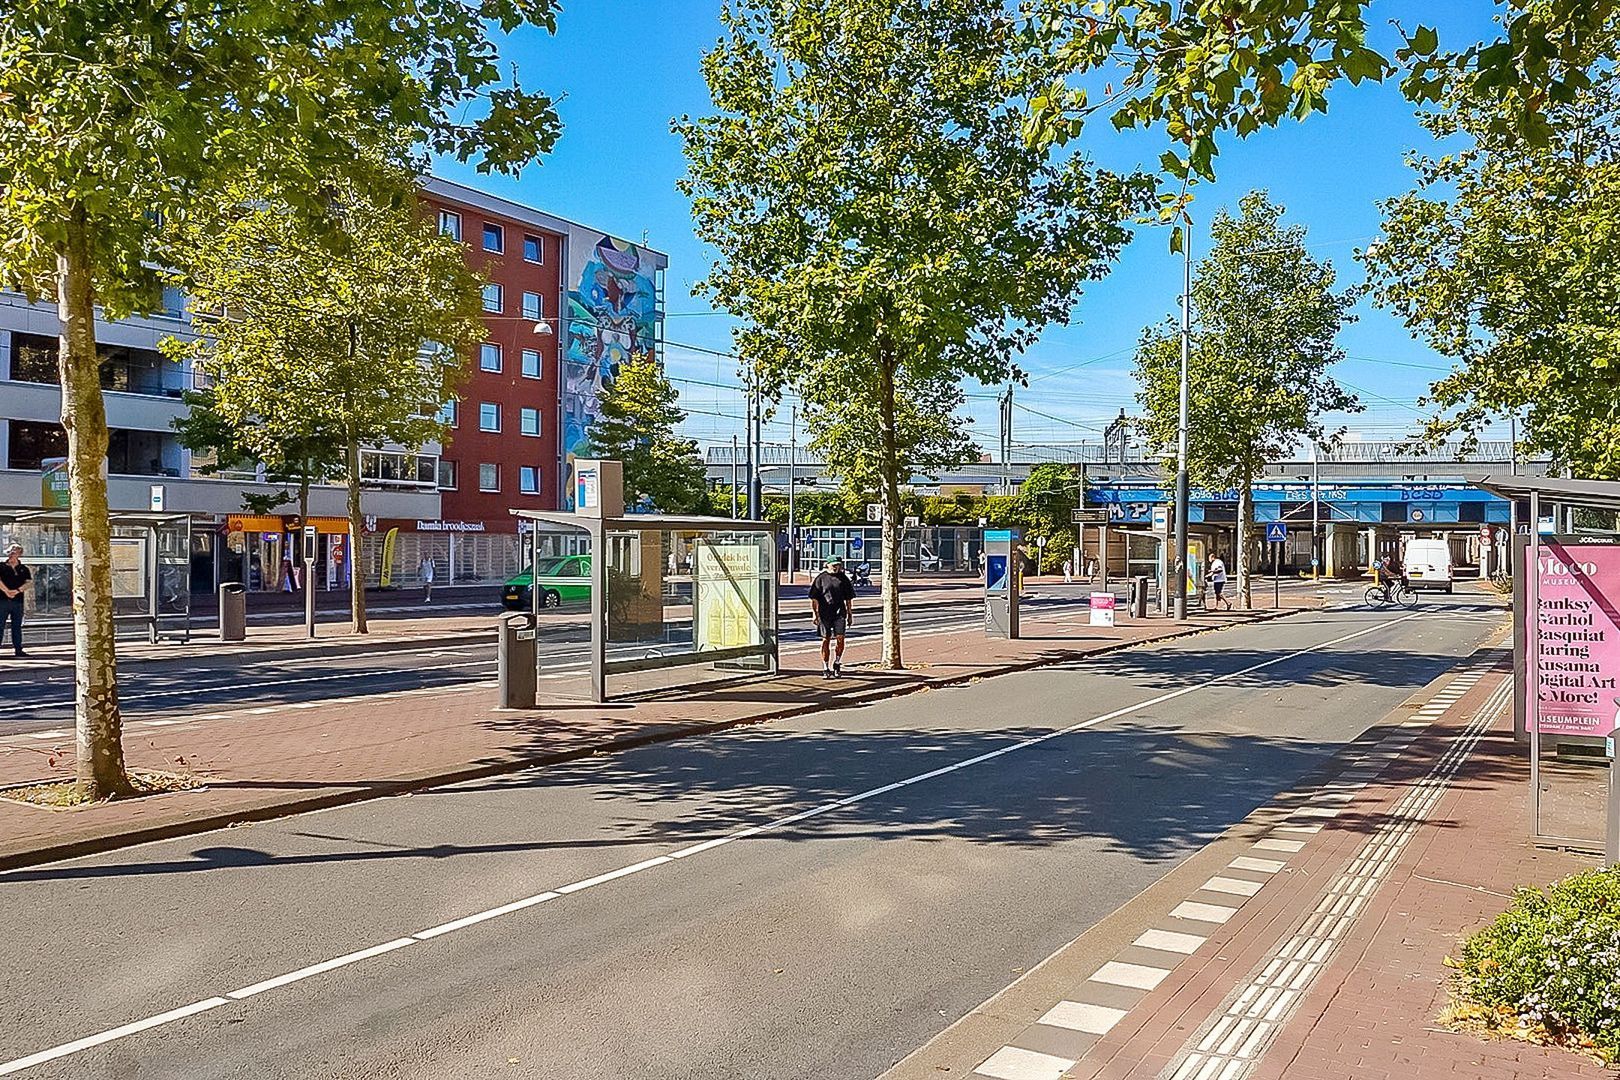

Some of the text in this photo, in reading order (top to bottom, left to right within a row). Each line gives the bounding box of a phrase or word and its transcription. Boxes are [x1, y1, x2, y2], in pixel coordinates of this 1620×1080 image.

[1587, 676, 1616, 688] Art
[1550, 690, 1598, 704] More!
[1539, 715, 1600, 725] USEUMPLEIN
